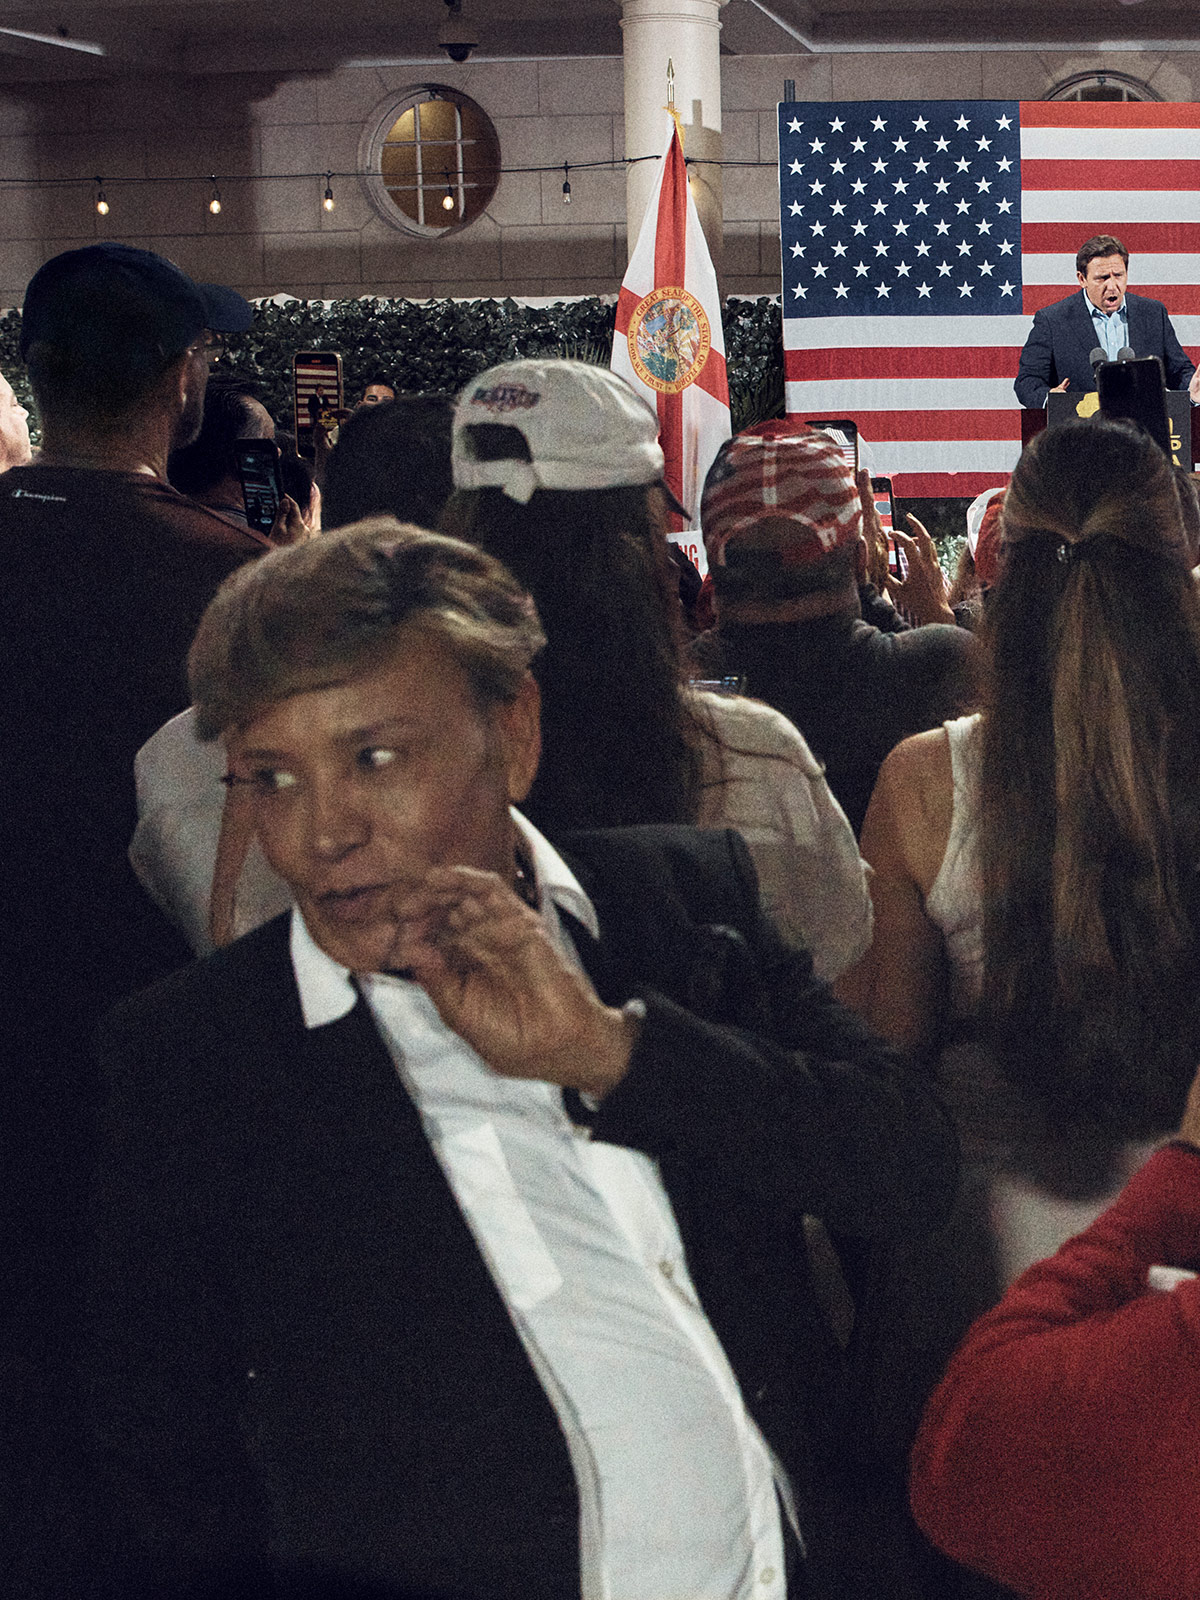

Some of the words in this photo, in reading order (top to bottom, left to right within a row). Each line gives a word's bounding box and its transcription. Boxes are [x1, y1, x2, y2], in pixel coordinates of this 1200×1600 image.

[636, 294, 659, 317] GREAT
[690, 302, 705, 320] THE
[629, 330, 635, 340] IN
[701, 322, 709, 351] STATE
[698, 354, 706, 367] OF
